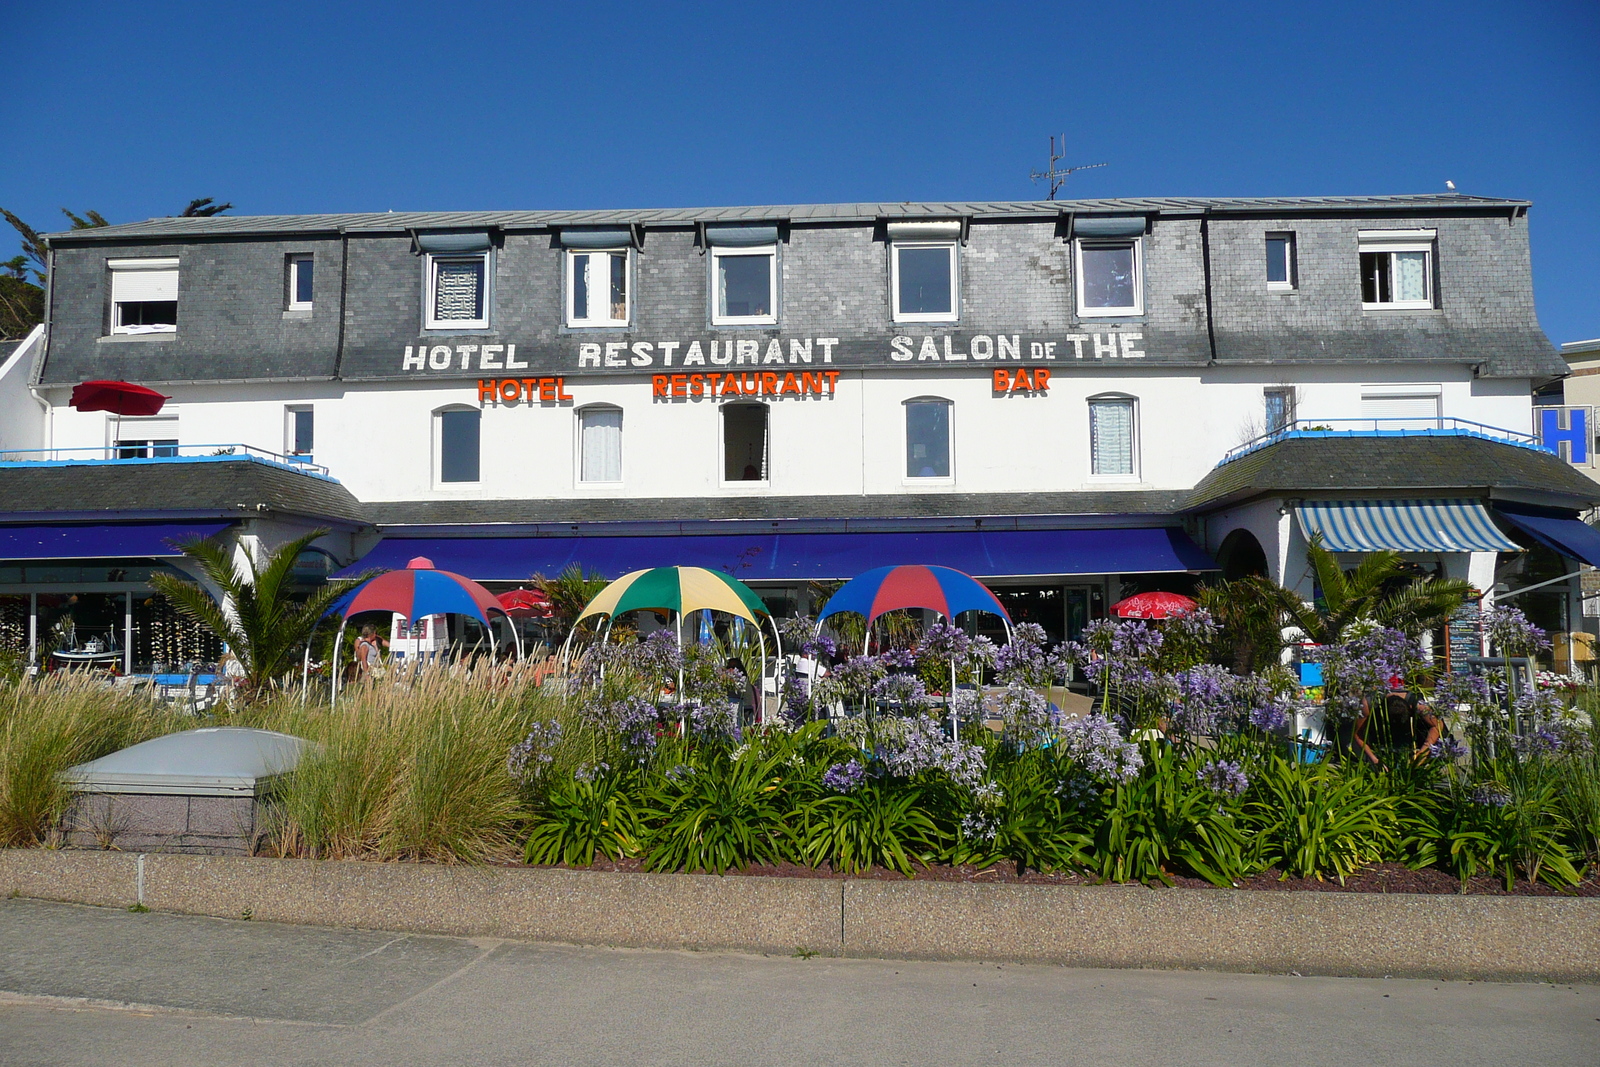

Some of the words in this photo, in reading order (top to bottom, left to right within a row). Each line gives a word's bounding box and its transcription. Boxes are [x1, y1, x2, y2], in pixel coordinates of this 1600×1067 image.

[402, 344, 529, 371] HOTEL
[577, 337, 840, 368] RESTAURANT
[890, 334, 1021, 362] SALON
[1030, 341, 1057, 360] DE
[1066, 332, 1146, 359] THE
[477, 377, 574, 402] HOTEL
[652, 371, 840, 397] RESTAURANT
[993, 368, 1051, 391] BAR
[1541, 409, 1588, 464] H
